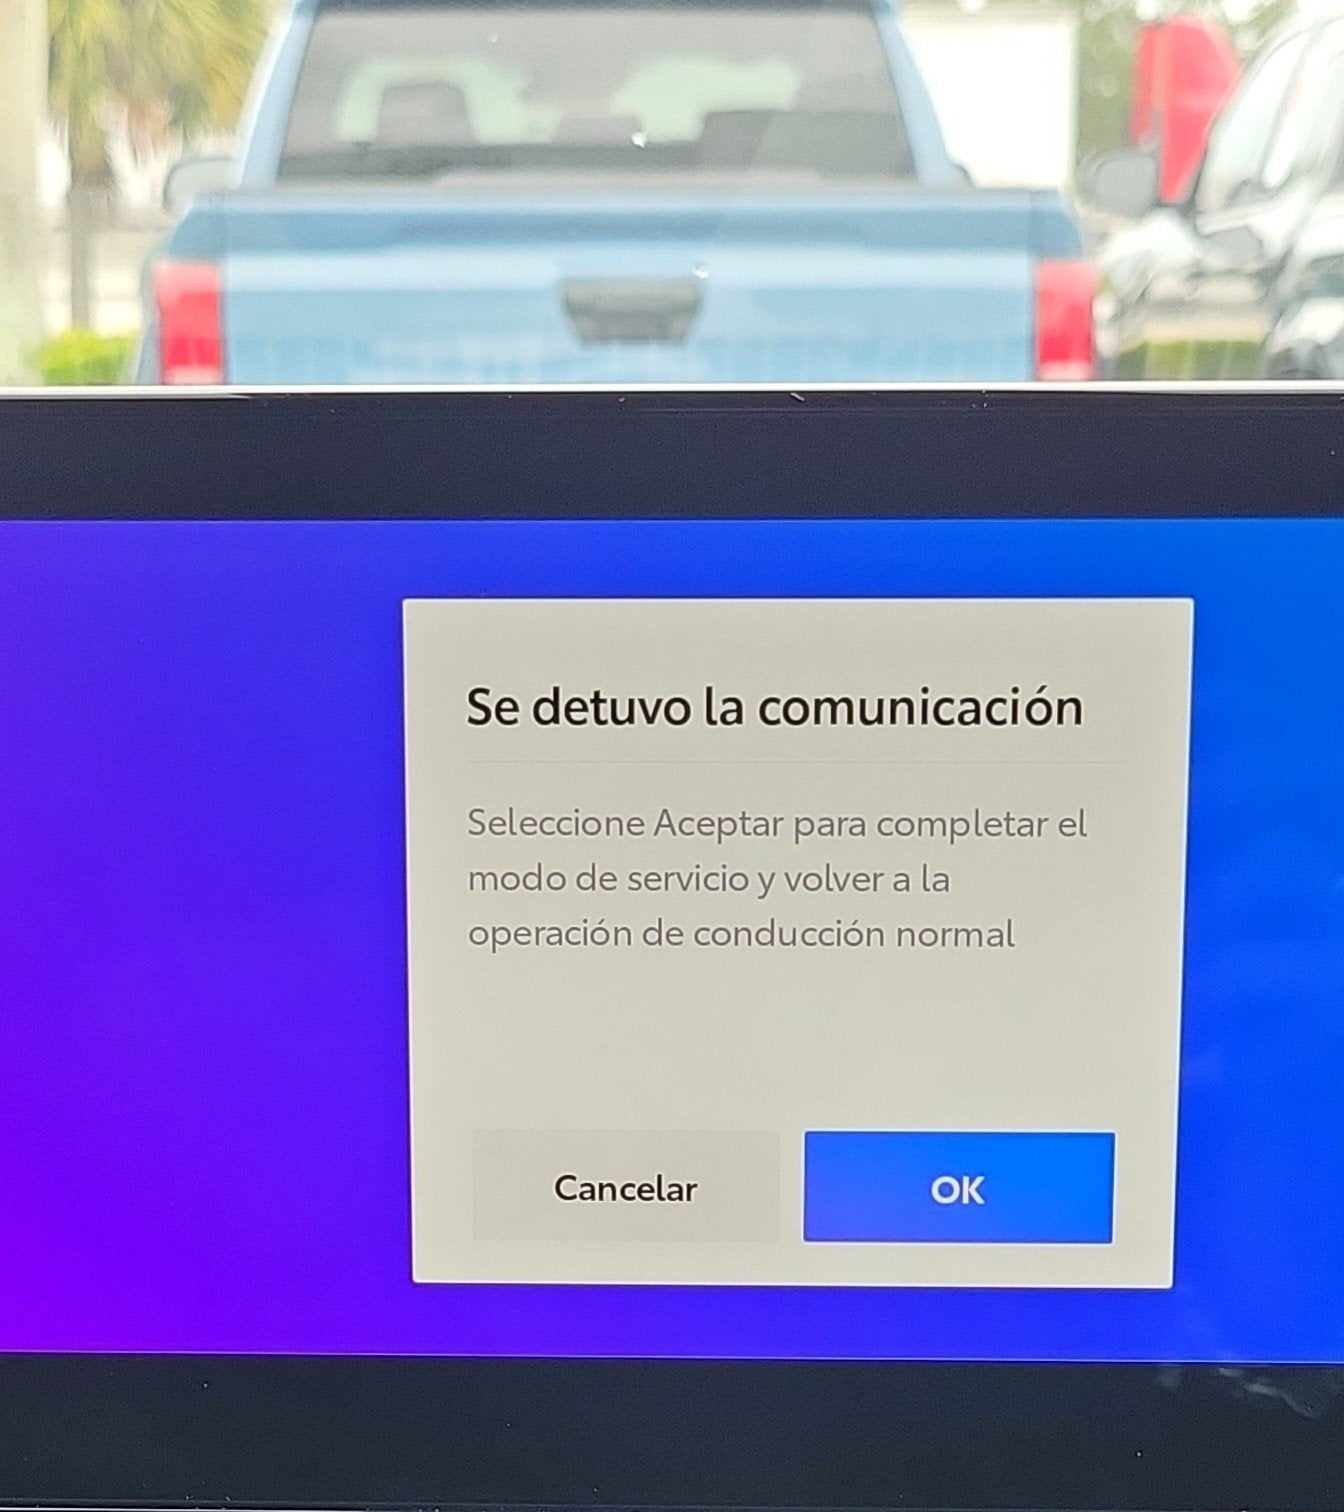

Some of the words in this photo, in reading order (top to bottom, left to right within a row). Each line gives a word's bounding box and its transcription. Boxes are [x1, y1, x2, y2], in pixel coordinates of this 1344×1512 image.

[467, 687, 519, 726] Se
[533, 687, 691, 726] detuvo
[705, 687, 744, 726] la
[758, 686, 1083, 726] comunicación
[468, 808, 645, 839] Seleccione
[654, 809, 784, 846] Aceptar
[794, 815, 866, 846] para
[877, 808, 1049, 846] completar
[1057, 808, 1088, 839] el
[469, 864, 567, 893] modo
[576, 864, 618, 893] de
[627, 864, 749, 893] servicio
[757, 871, 777, 900] y
[785, 864, 884, 894] volver
[892, 872, 911, 894] a
[921, 864, 951, 894] la
[469, 919, 633, 953] operación
[643, 919, 684, 948] de
[693, 919, 885, 949] conducción
[896, 919, 1015, 949] normal
[554, 1175, 698, 1203] Cancelar
[931, 1176, 985, 1206] OK
